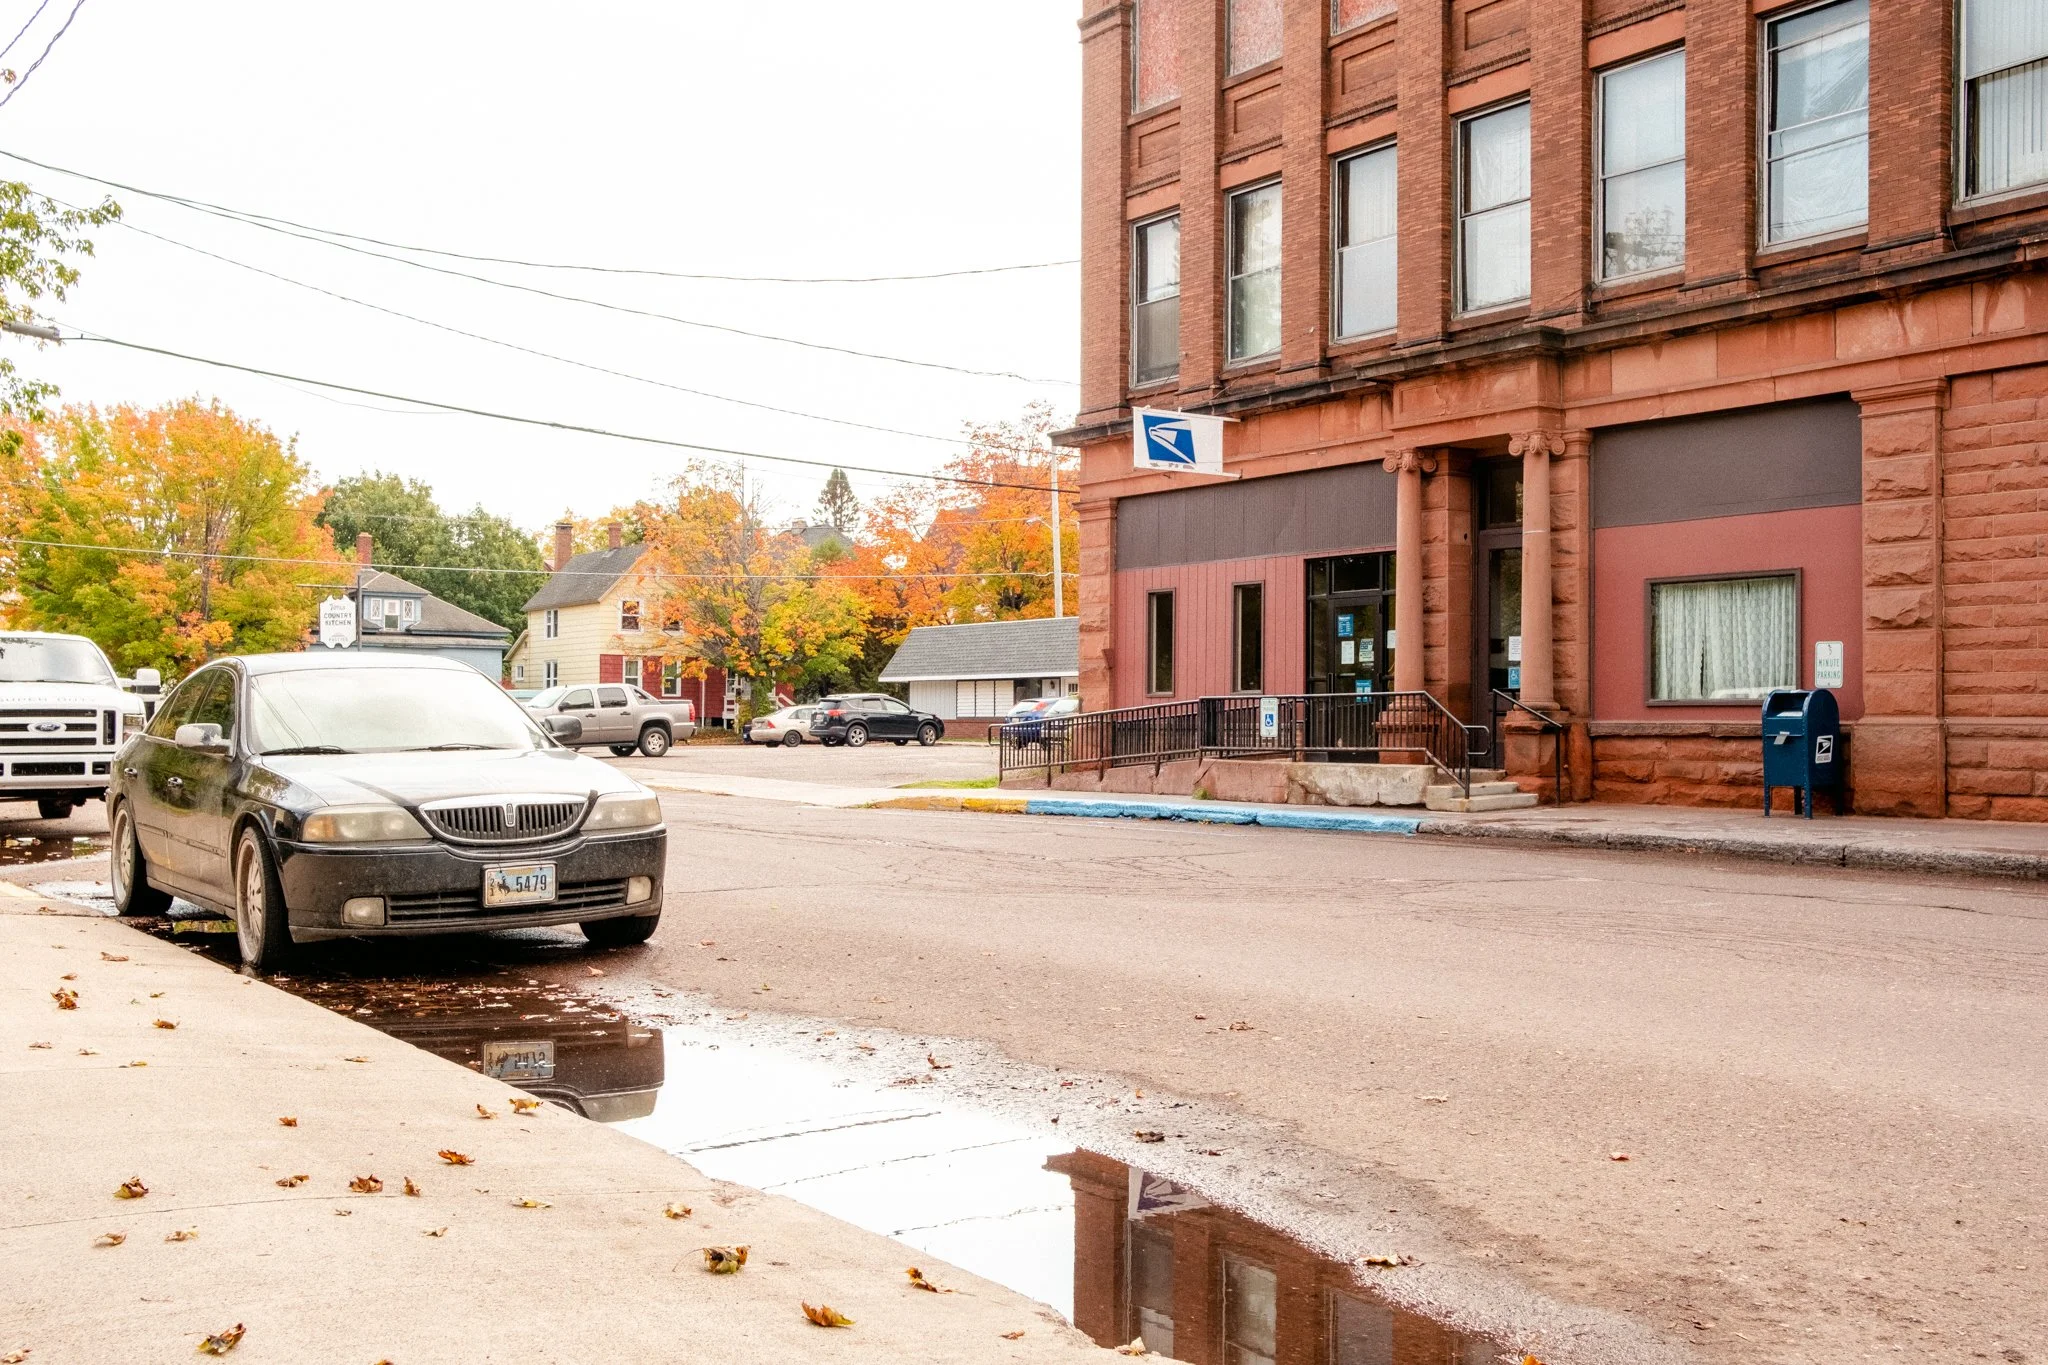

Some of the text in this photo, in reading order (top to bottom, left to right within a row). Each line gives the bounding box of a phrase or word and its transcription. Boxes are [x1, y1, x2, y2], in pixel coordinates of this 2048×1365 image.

[1818, 658, 1840, 668] MINUTE
[1817, 670, 1841, 679] PARKING
[515, 874, 547, 893] 5479
